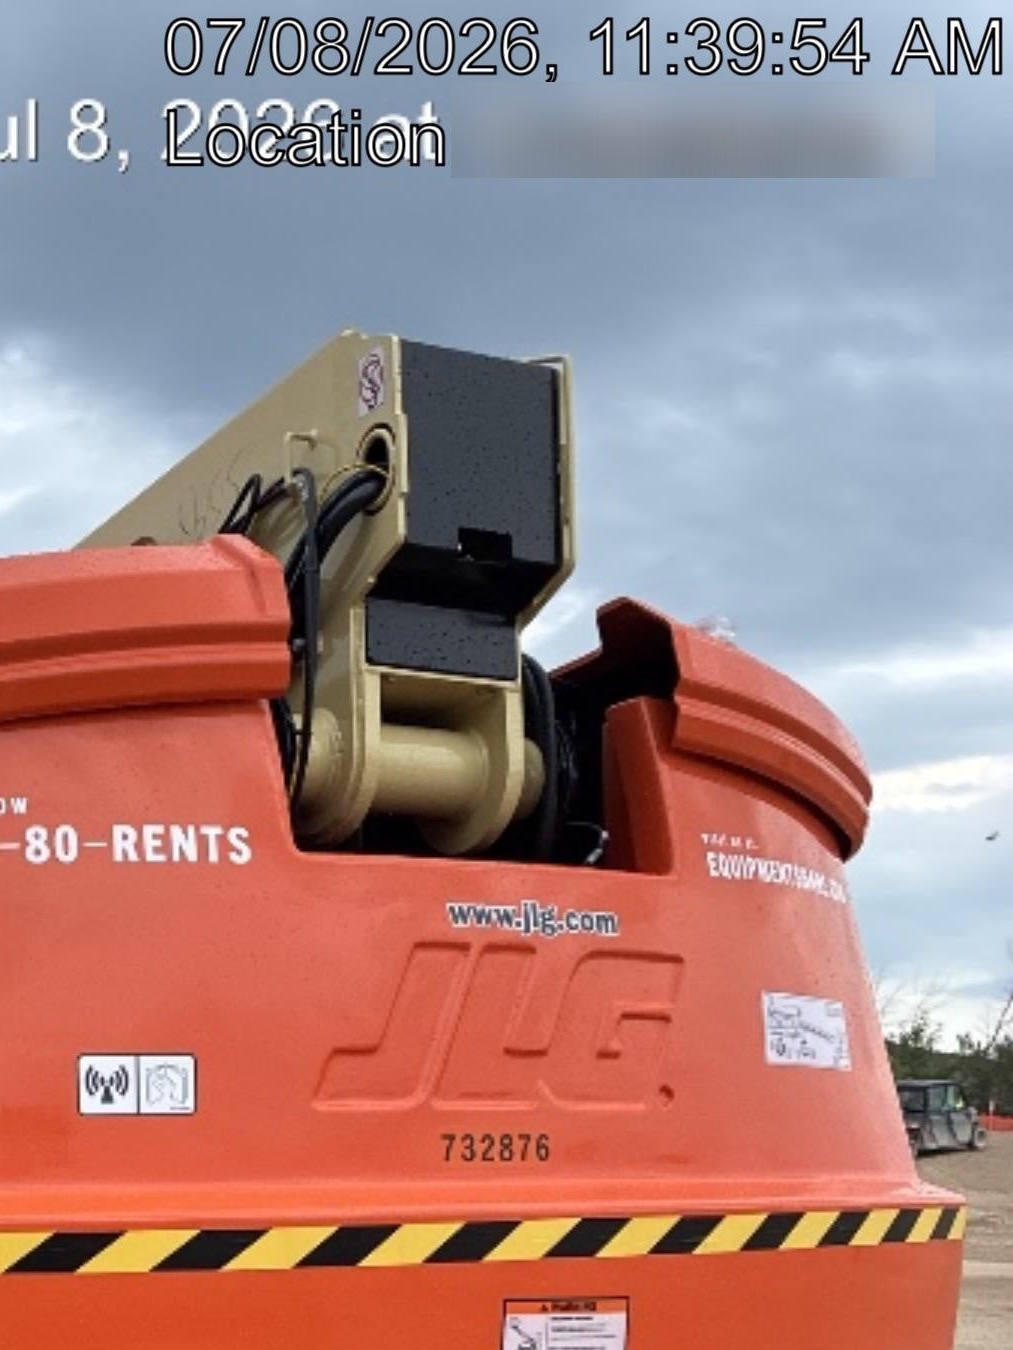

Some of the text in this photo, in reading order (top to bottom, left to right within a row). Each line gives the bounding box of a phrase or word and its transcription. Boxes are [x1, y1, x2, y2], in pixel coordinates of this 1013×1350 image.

[447, 901, 620, 938] www.jlg.com
[311, 940, 685, 1111] JLG
[440, 1133, 551, 1163] 732876
